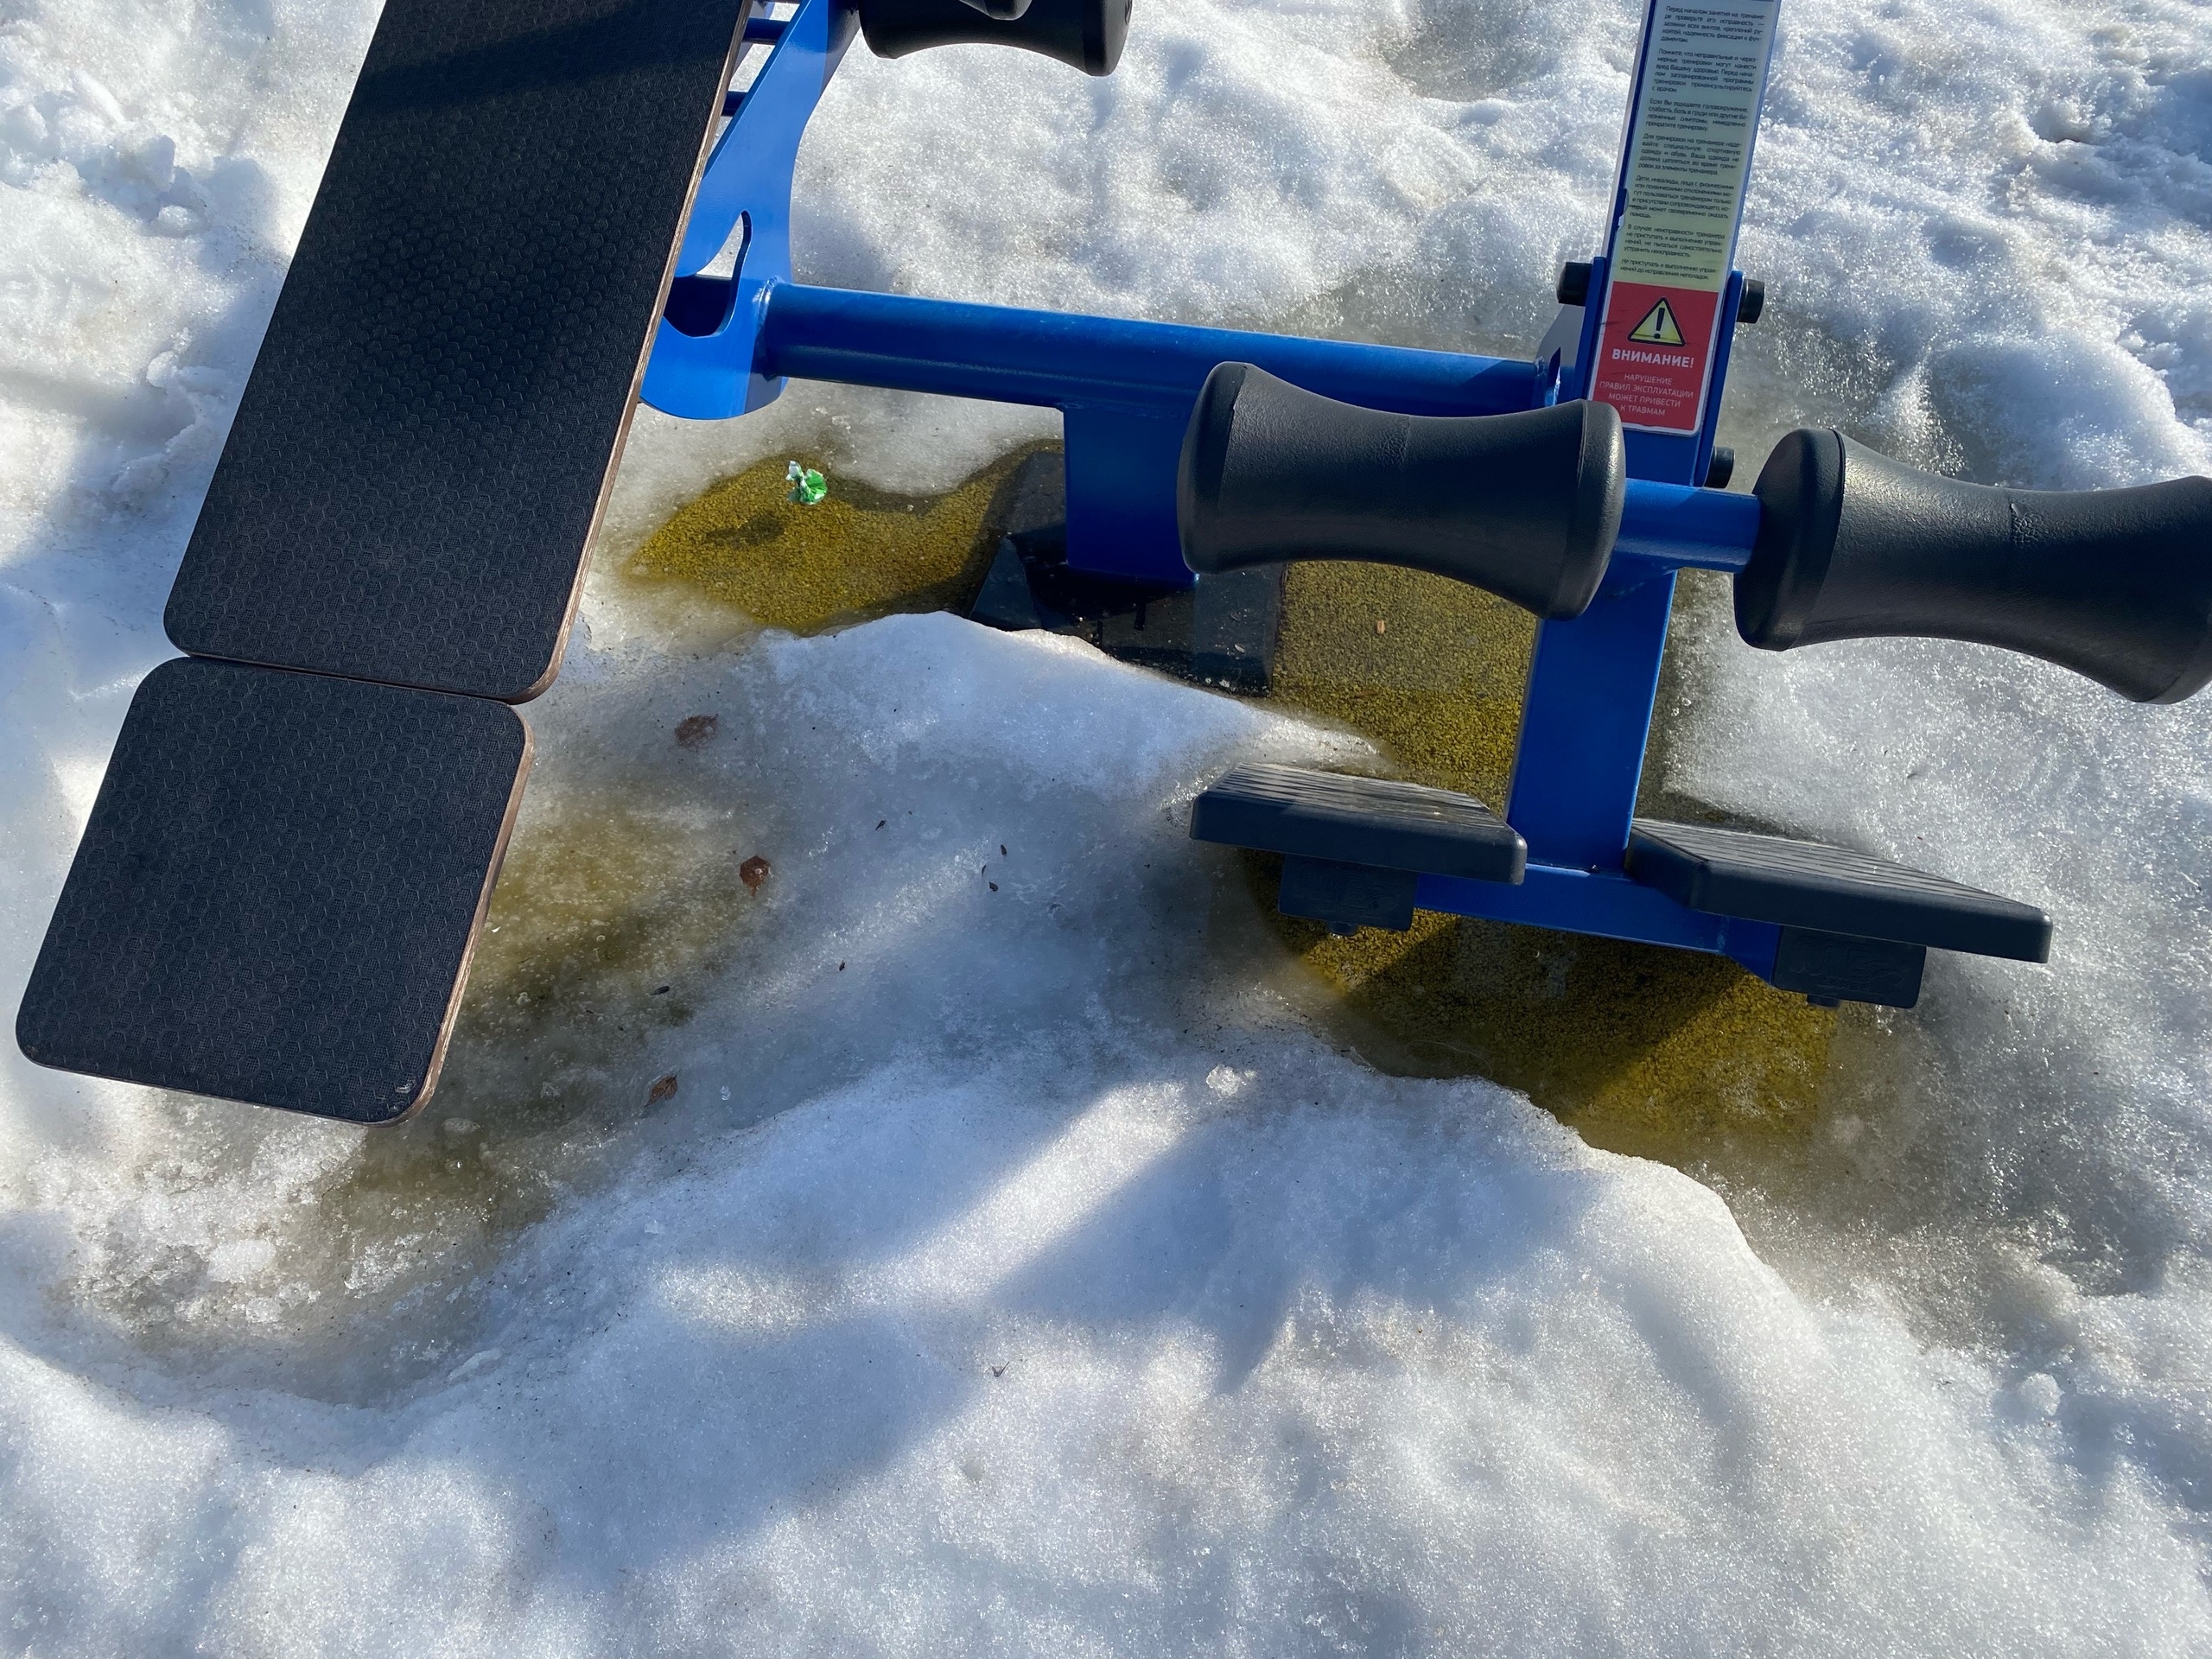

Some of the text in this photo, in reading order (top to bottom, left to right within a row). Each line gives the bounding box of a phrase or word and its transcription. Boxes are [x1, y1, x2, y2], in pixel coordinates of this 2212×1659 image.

[1612, 349, 1694, 368] ВНИМАНИЕ!
[1624, 373, 1673, 385] НАРУШЕНИЕ
[1599, 381, 1694, 398] ПРАВИЛ ЭКСПЛУАТАЦИИ
[1609, 393, 1681, 408] МОЖЕТ ПРИВЕСТИ
[1628, 405, 1666, 416] ТРАВМАМ
